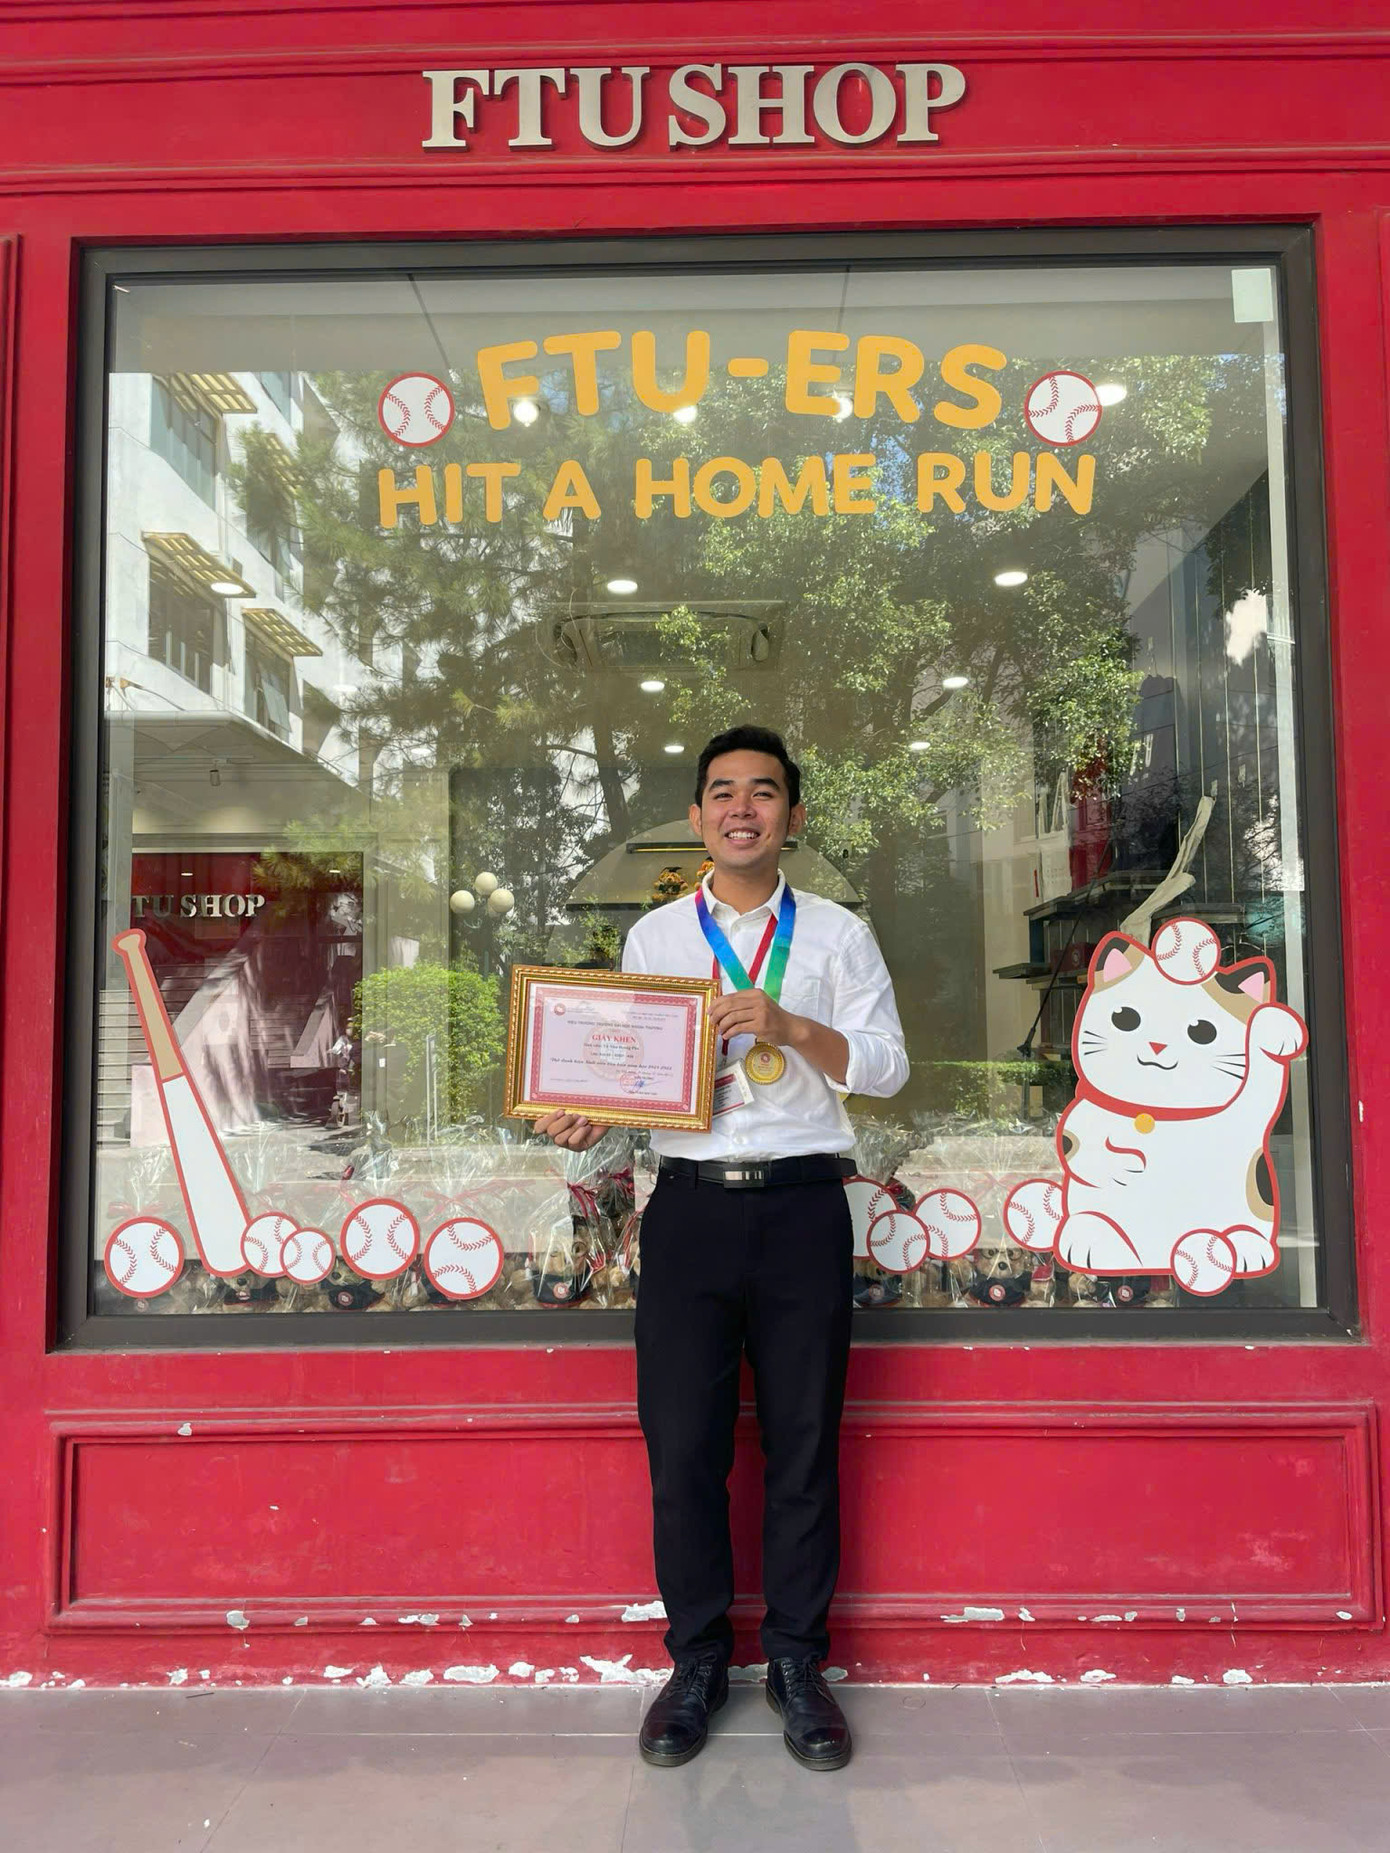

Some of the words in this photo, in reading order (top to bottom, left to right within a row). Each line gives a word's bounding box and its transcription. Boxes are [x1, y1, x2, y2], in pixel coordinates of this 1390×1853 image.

[422, 66, 652, 151] FTU
[667, 62, 967, 150] SHOP
[477, 330, 1008, 430] FTU-ERS
[378, 462, 522, 529] HIT
[543, 460, 601, 521] A
[635, 453, 877, 519] HOME
[917, 451, 1097, 516] RUN
[180, 894, 266, 918] SHOP
